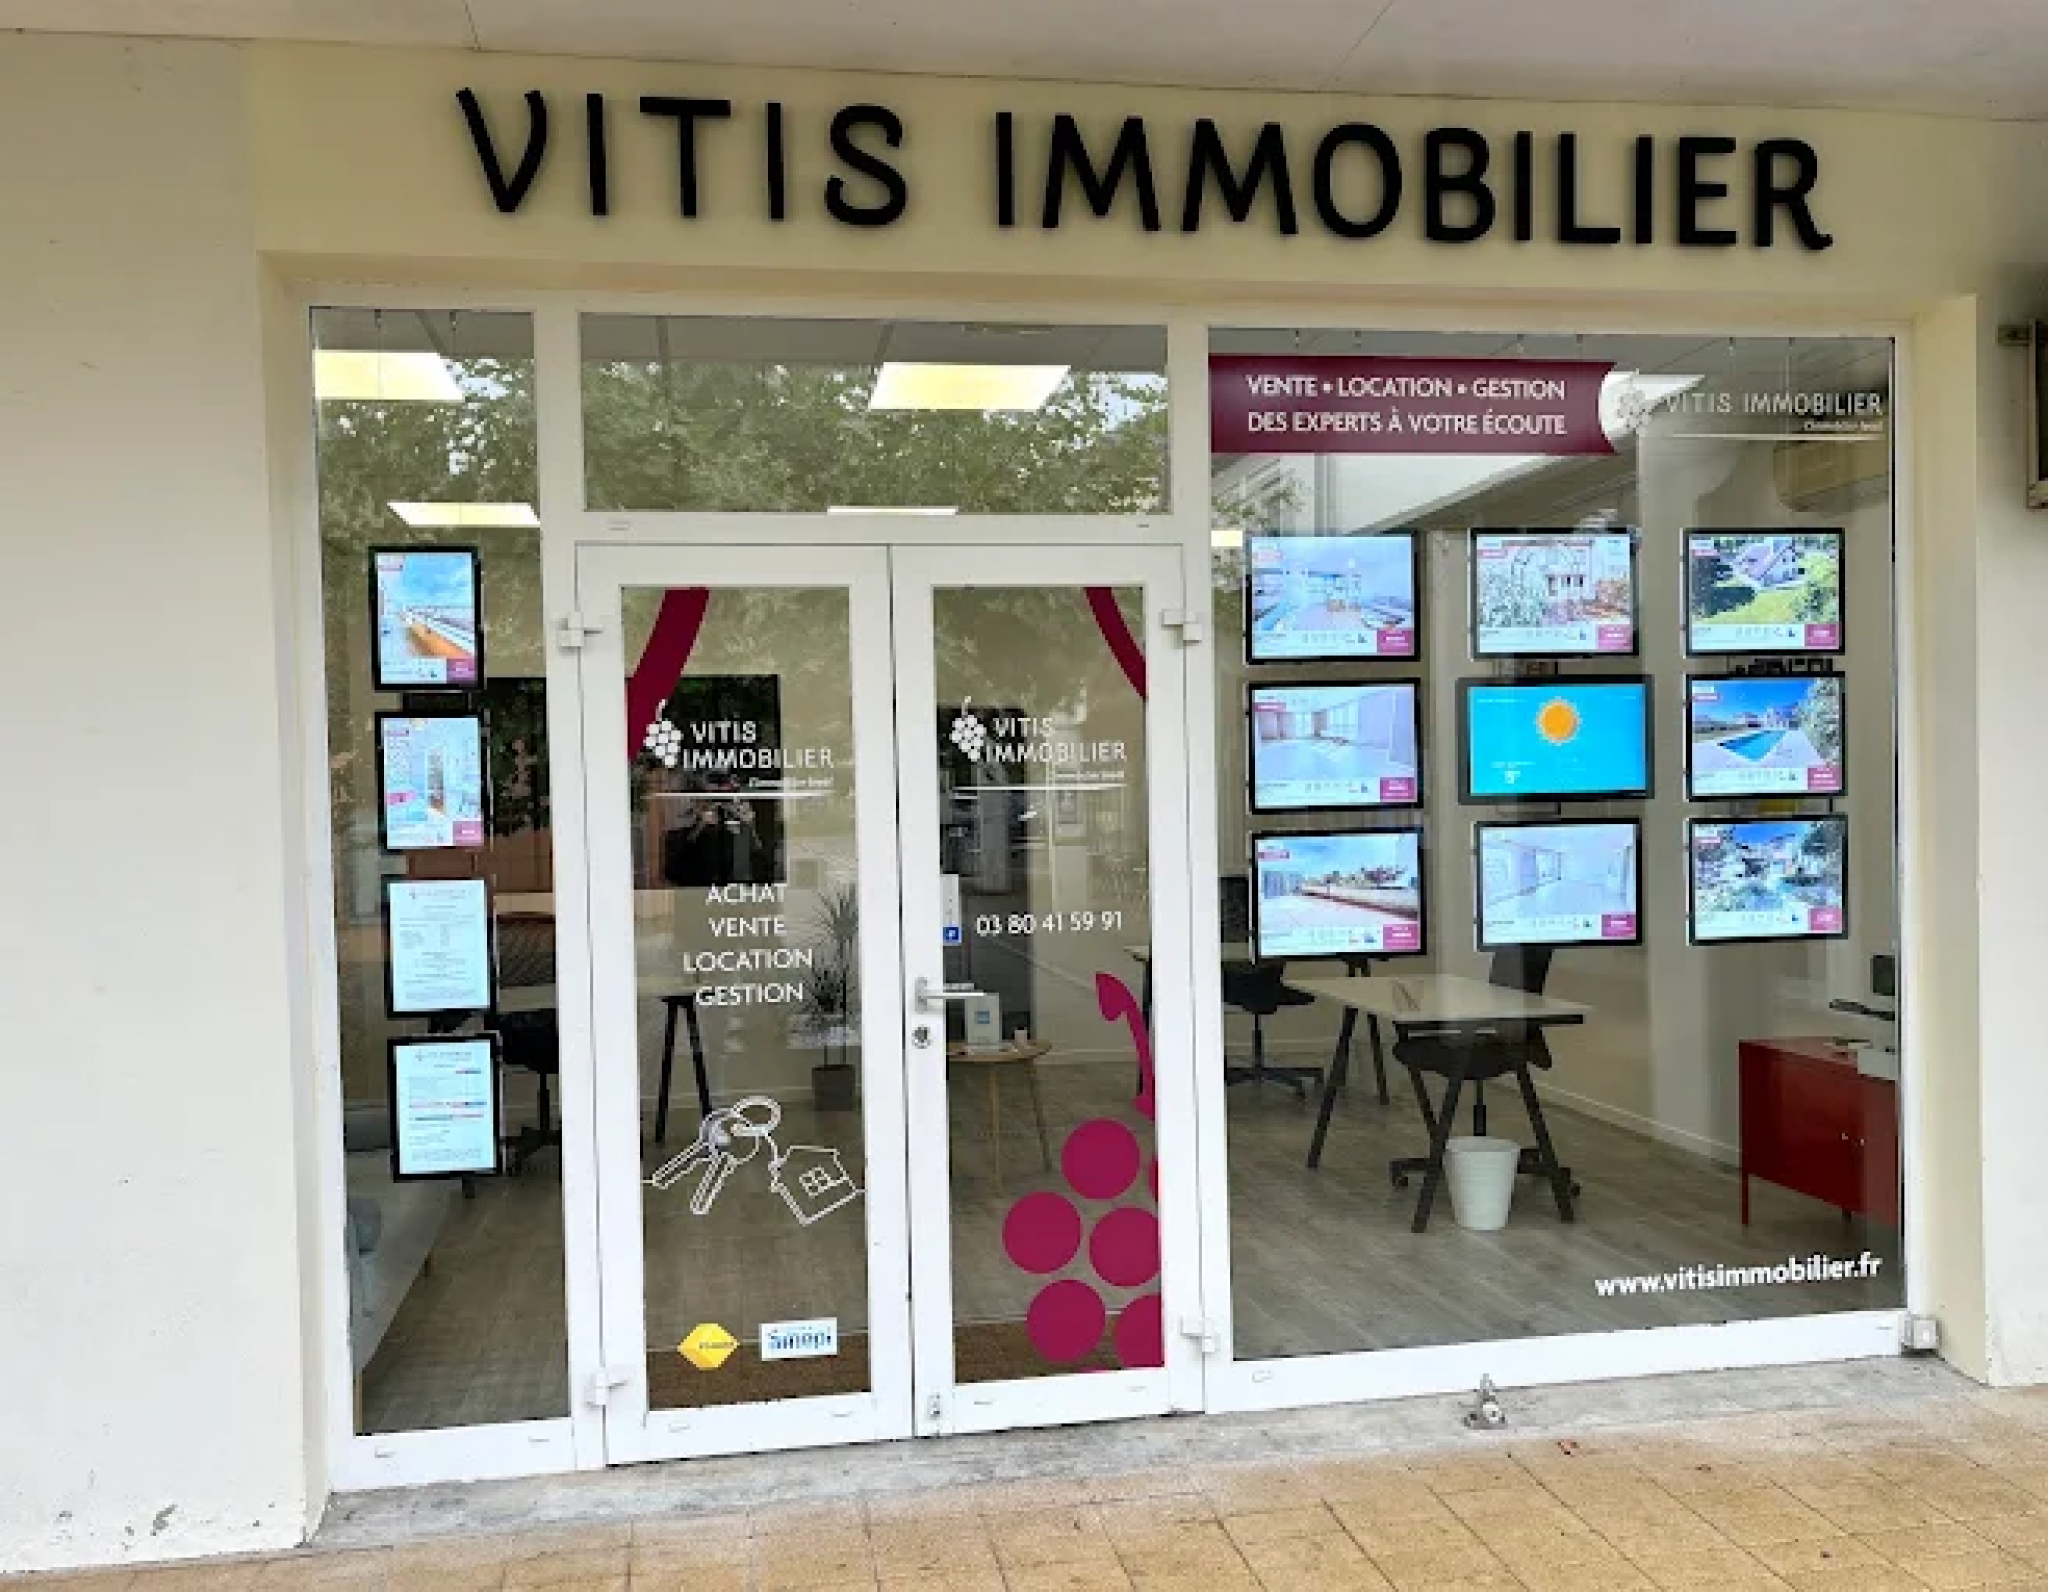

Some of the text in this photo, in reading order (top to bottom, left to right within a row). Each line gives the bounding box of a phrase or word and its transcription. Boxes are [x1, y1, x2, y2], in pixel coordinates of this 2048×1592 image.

[455, 86, 1833, 250] VITIS IMMOBILIER
[1247, 374, 1566, 400] VENTE LOCATION GESTION
[1667, 391, 1884, 416] VITIS IMMOBILIER
[1248, 405, 1567, 435] DES EXPERTS À VOTRE ÉCOUTE
[690, 720, 757, 744] VITIS
[993, 717, 1053, 738] VITIS
[683, 747, 835, 771] IMMOBILIER
[985, 741, 1127, 764] IMMOBILIER
[706, 883, 787, 905] ACHAT
[708, 916, 787, 937] VENTE
[976, 910, 1122, 936] 03 80 41 59 91
[683, 949, 813, 973] LOCATION
[695, 982, 804, 1006] GESTION
[1594, 1250, 1883, 1297] www.vitisimmobilier.fr
